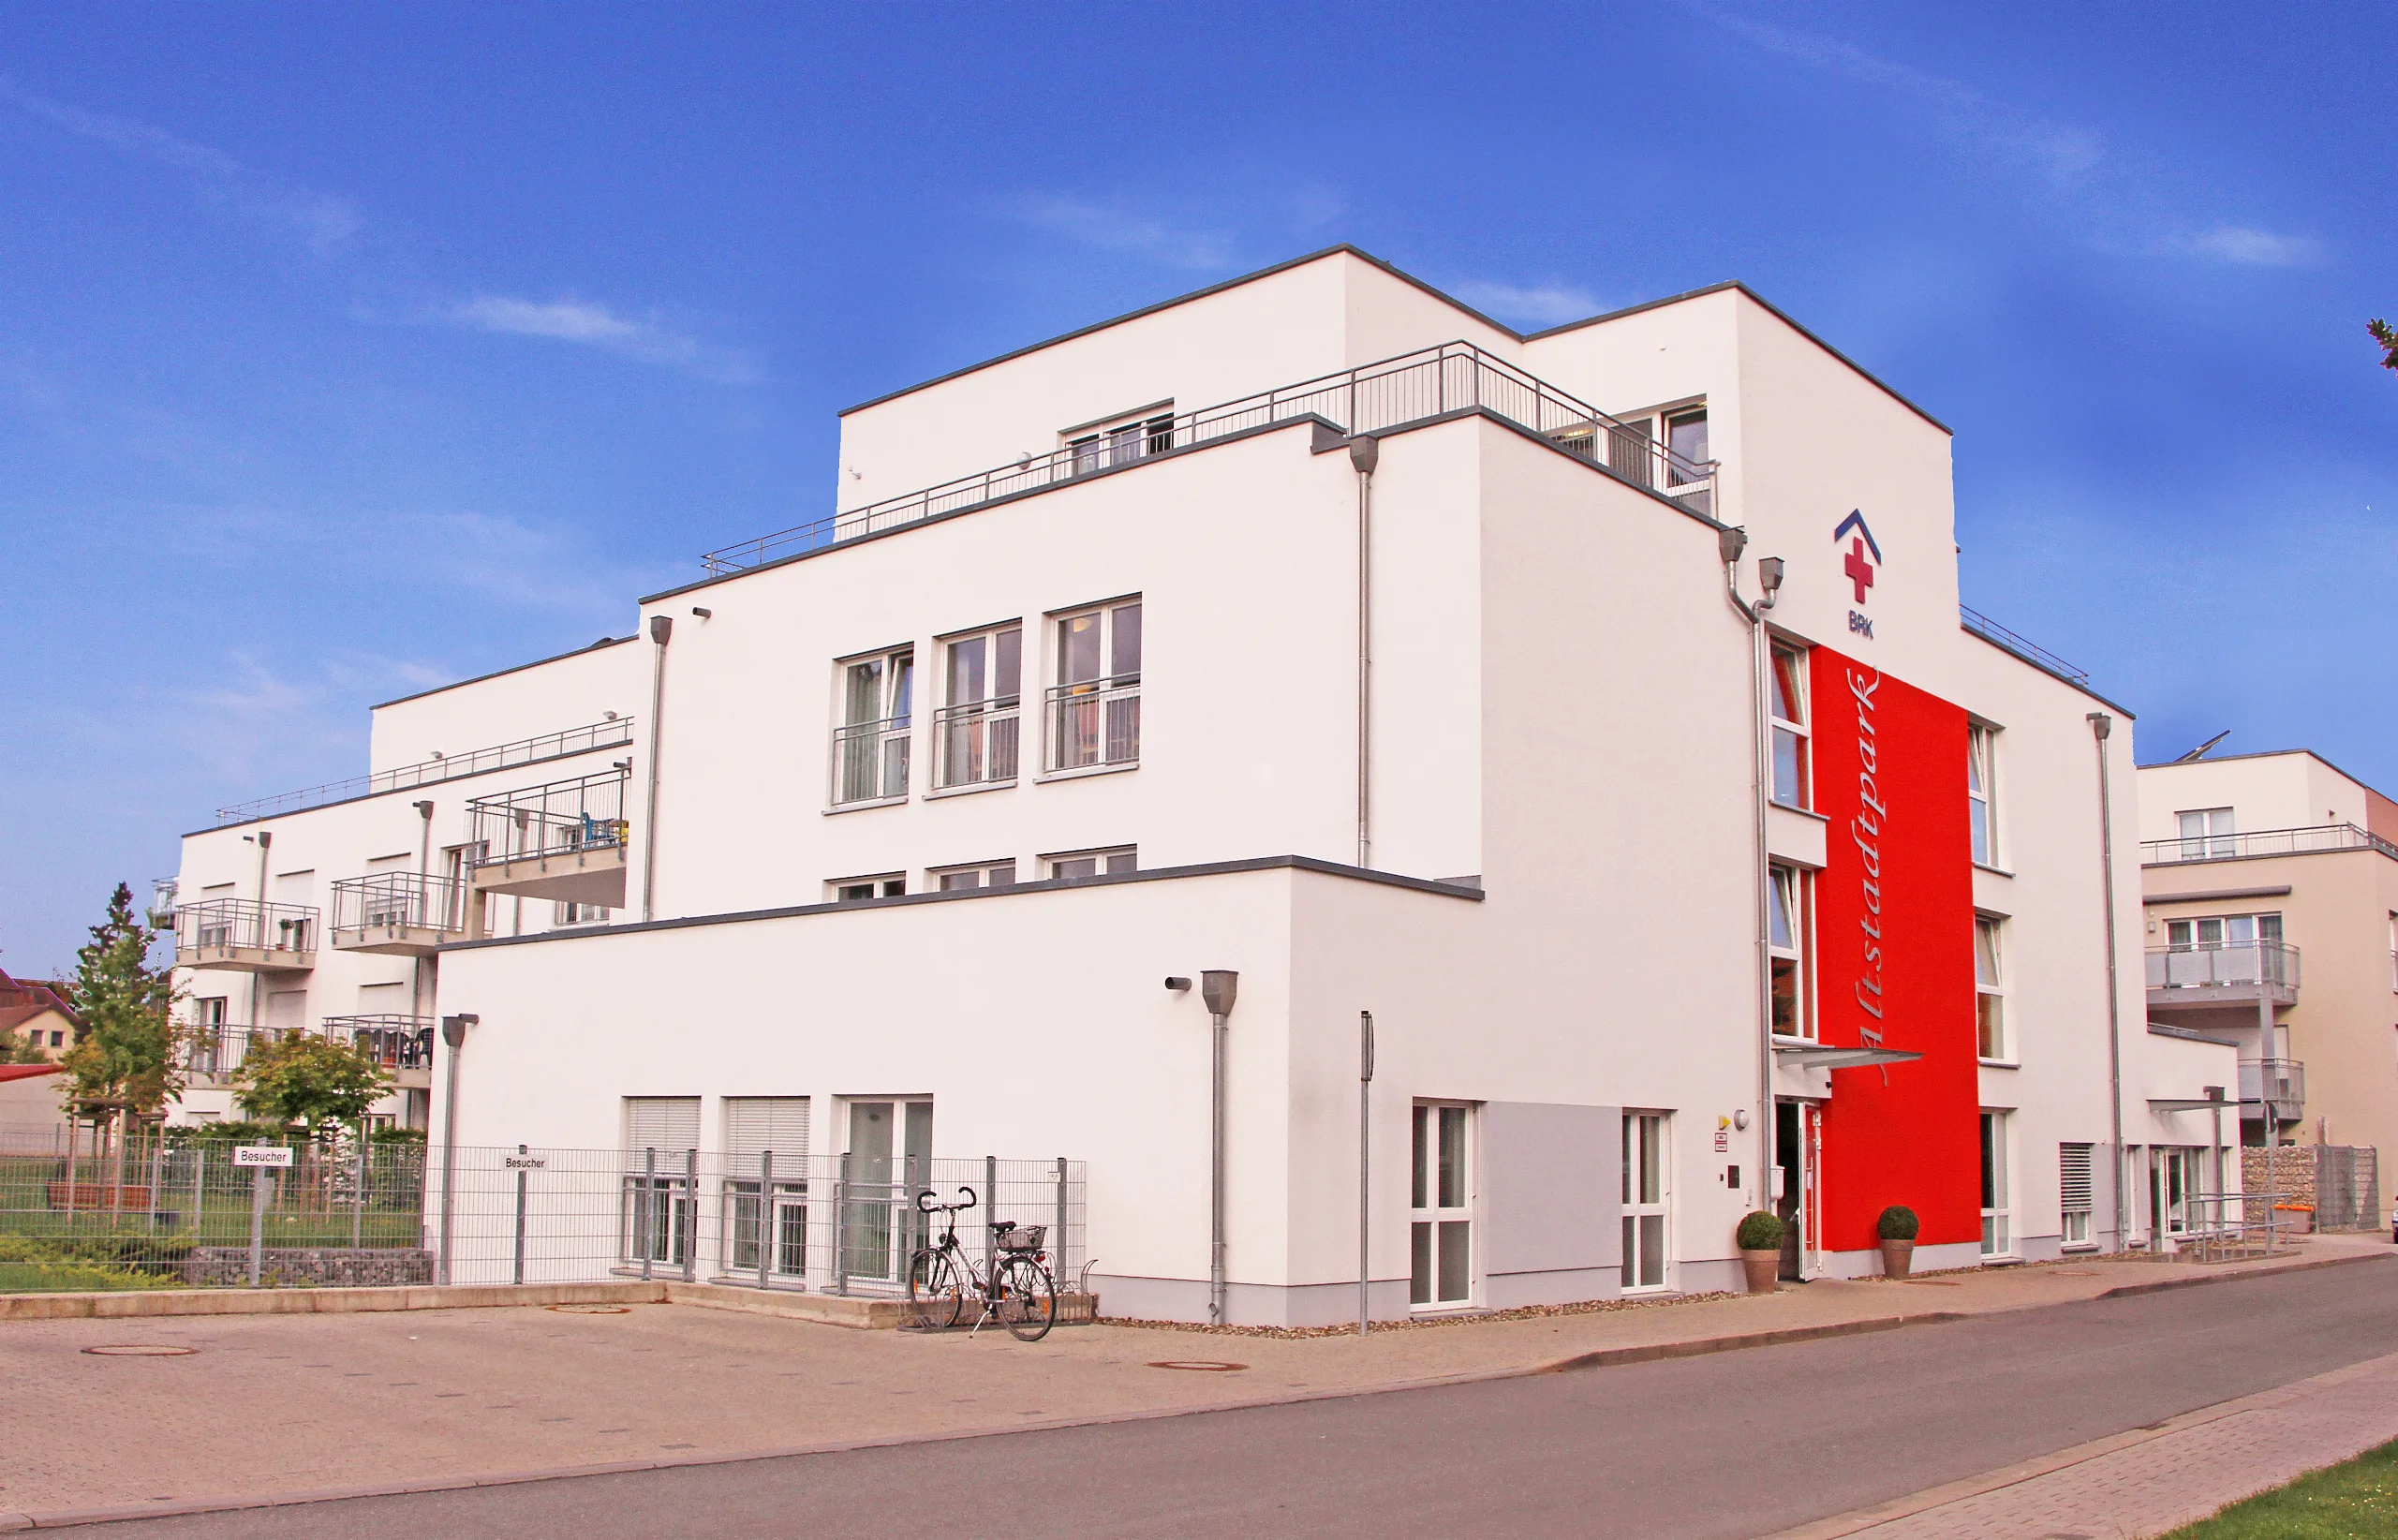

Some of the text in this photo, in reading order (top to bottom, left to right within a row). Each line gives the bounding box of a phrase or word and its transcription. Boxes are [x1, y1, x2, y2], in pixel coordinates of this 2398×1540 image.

[1848, 609, 1873, 640] BRK
[241, 1150, 287, 1162] Besucher
[506, 1158, 544, 1168] Besucher
